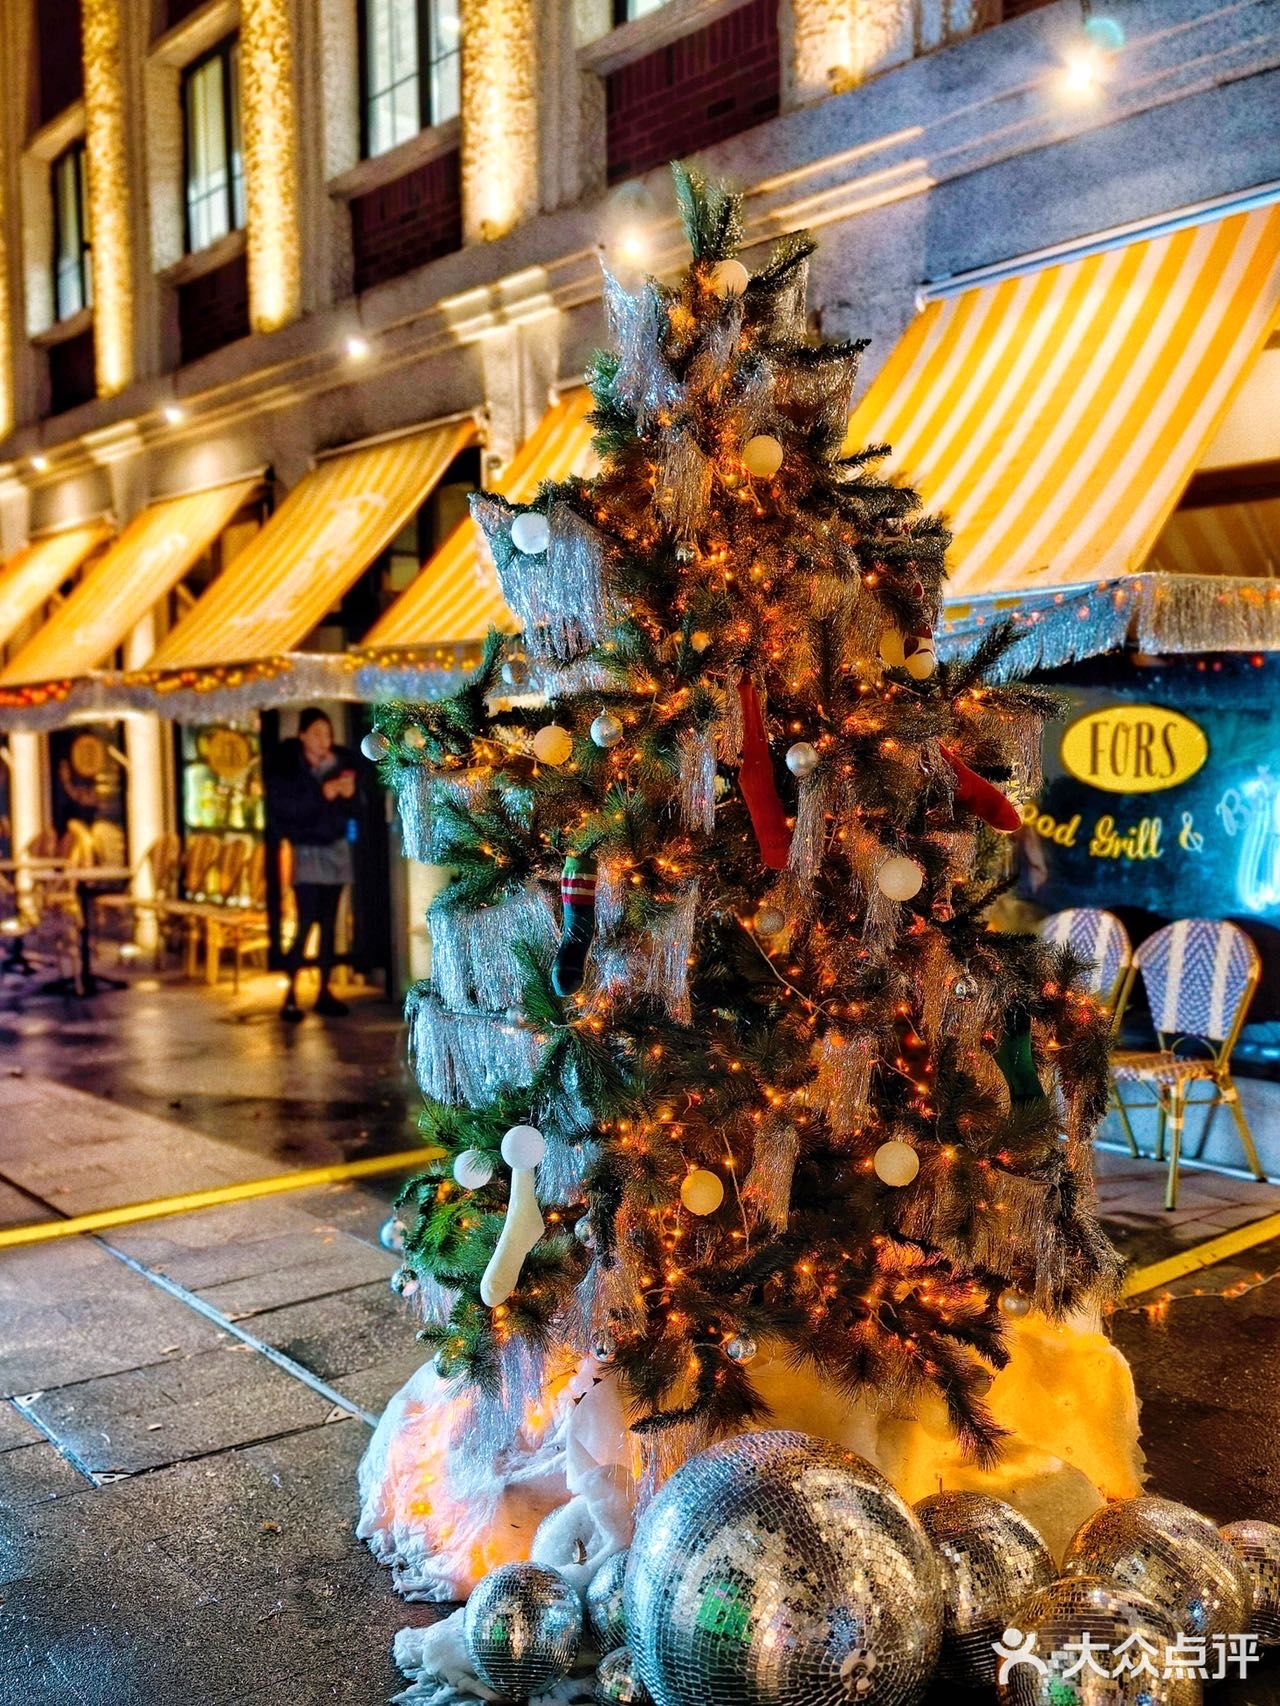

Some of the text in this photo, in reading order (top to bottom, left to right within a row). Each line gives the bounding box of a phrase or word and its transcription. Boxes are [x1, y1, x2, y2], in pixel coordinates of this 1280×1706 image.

[1088, 720, 1178, 779] FORS
[1021, 802, 1082, 848] ood
[1088, 814, 1165, 860] Grill
[1178, 811, 1204, 854] &
